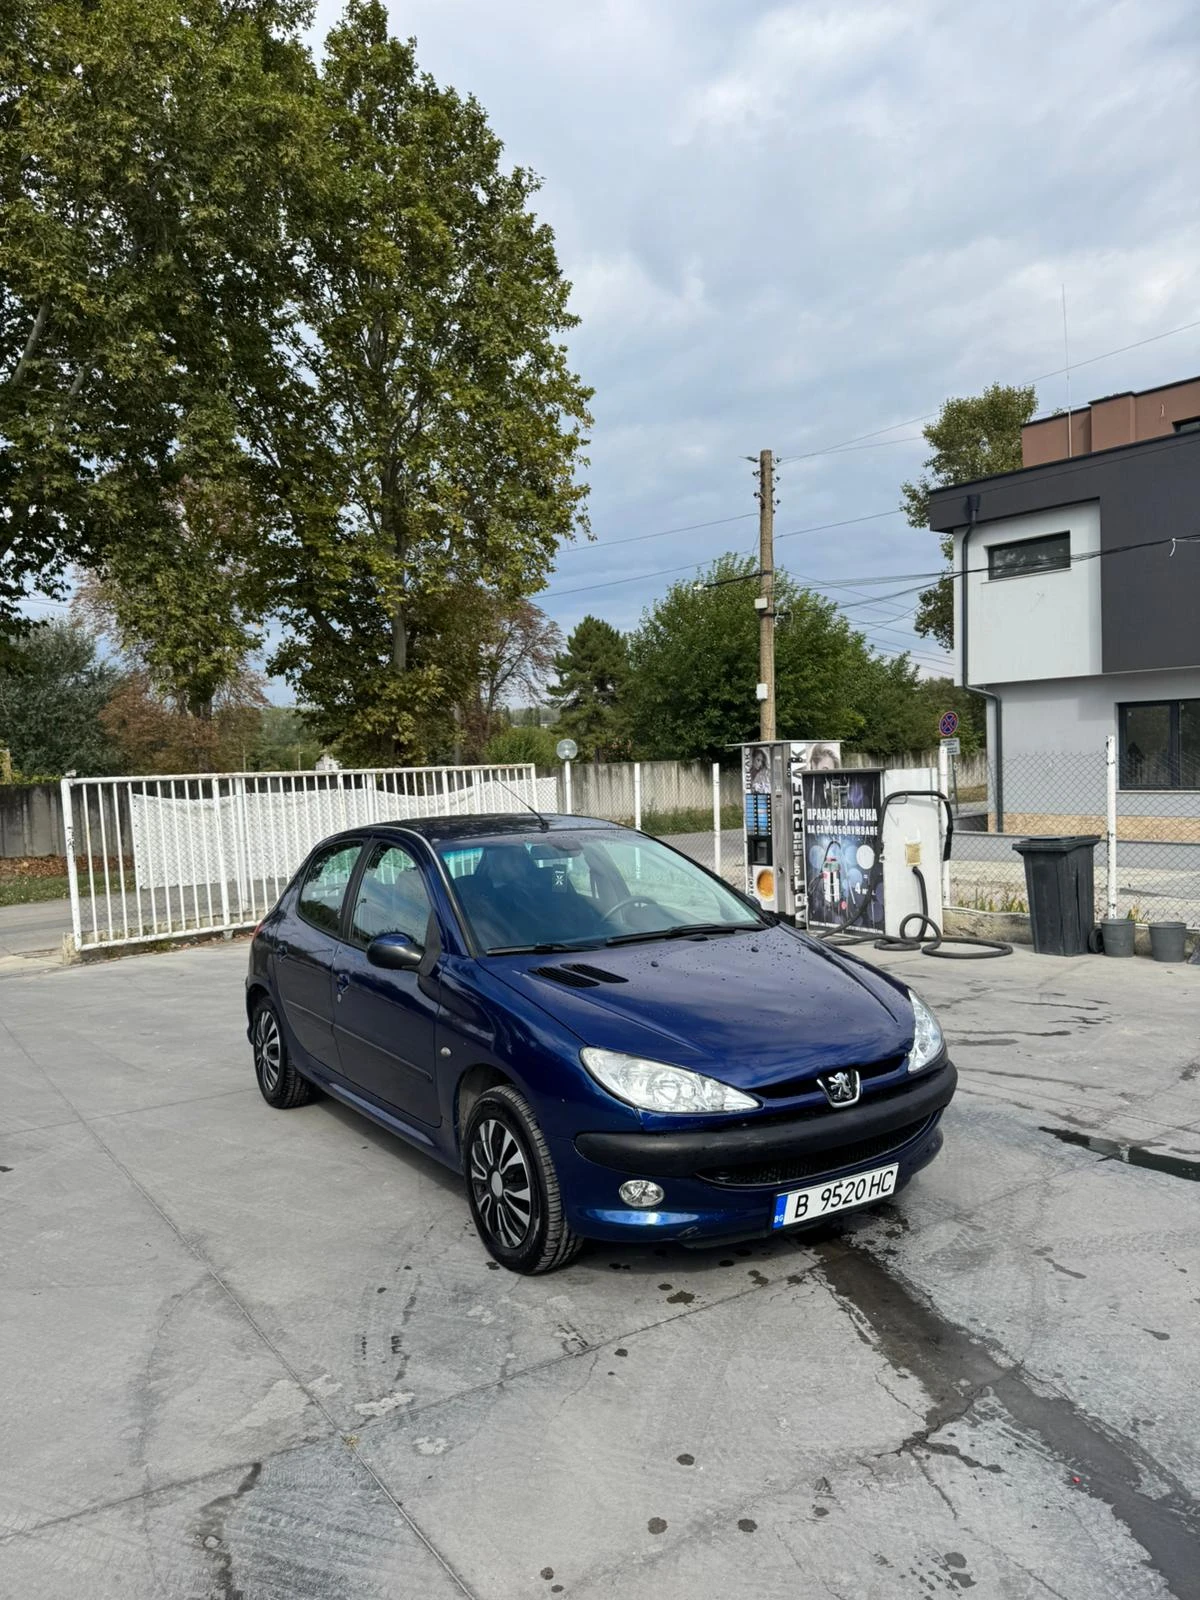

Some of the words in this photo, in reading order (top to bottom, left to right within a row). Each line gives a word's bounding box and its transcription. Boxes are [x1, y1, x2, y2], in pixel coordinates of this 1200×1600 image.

[807, 808, 878, 822] ПРАХОСМУКАЧКА
[794, 876, 807, 923] ART
[794, 1194, 809, 1218] B
[821, 1178, 866, 1211] 9520
[868, 1170, 894, 1197] HC
[773, 1214, 784, 1223] BG
